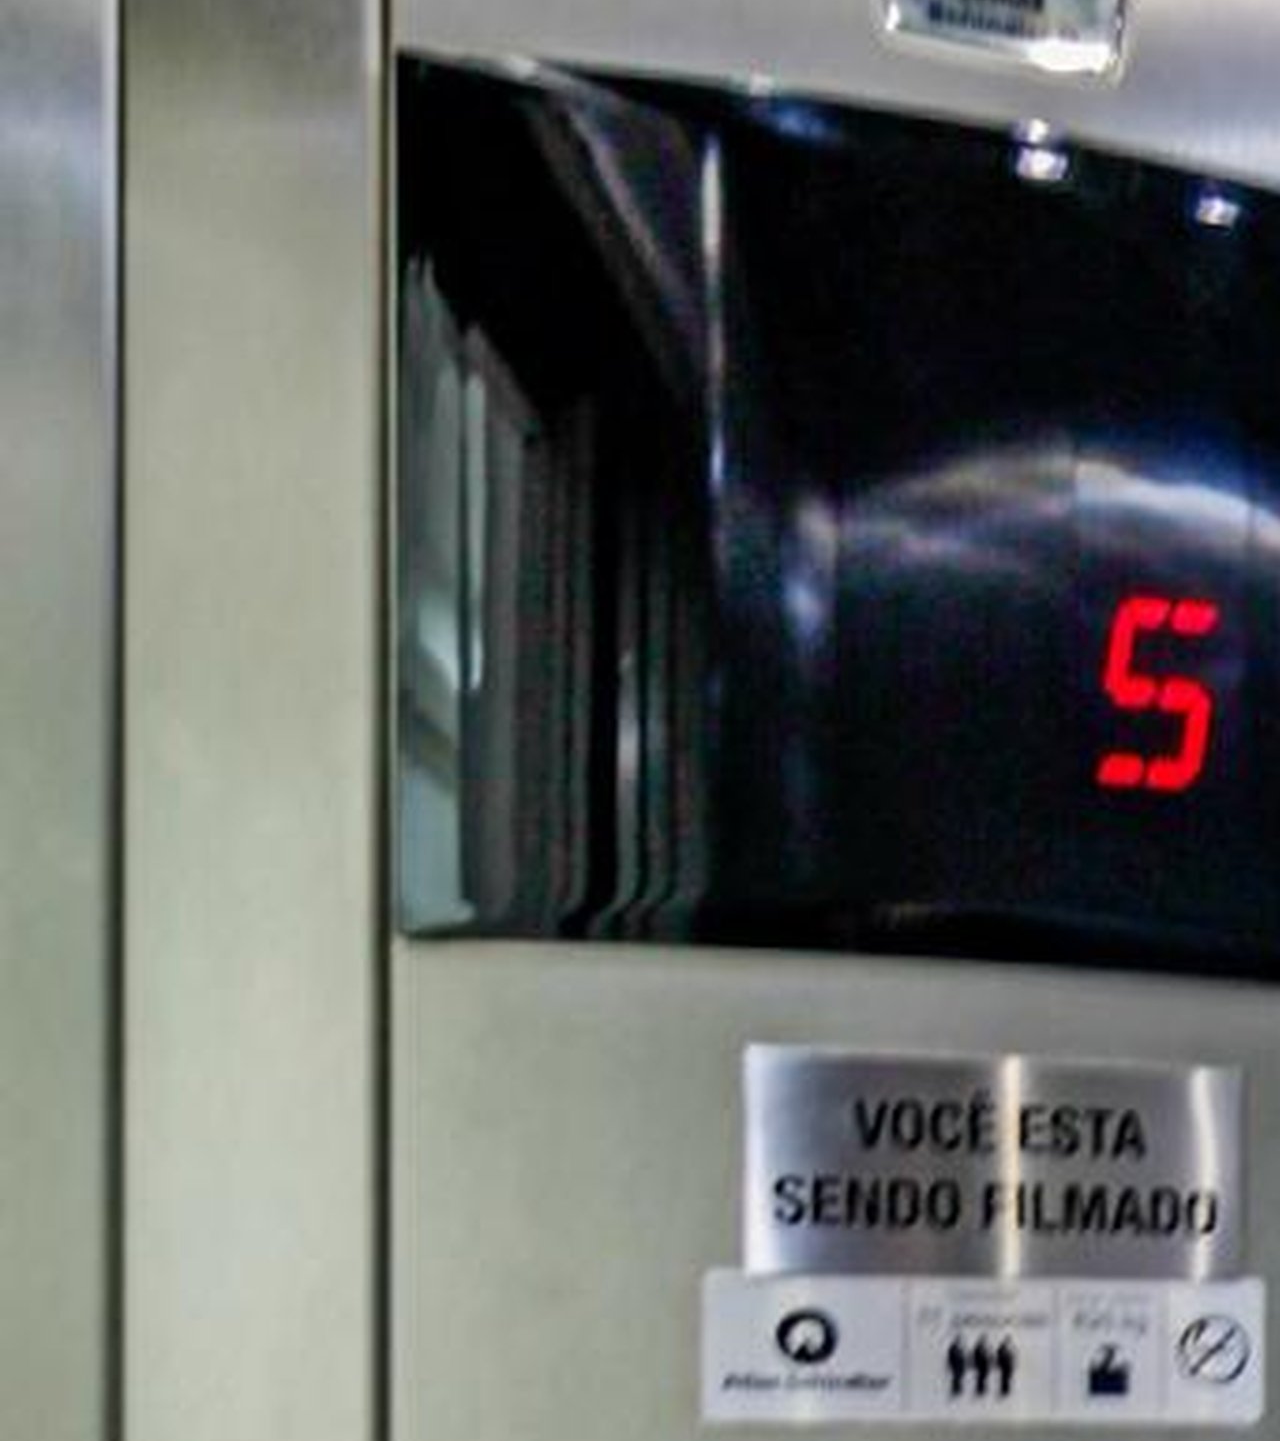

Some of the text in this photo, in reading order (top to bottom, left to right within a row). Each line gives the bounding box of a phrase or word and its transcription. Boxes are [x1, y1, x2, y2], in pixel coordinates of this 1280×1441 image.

[1094, 595, 1219, 795] 5
[853, 1089, 1149, 1160] VOCÊ ESTA
[774, 1174, 1219, 1237] SENDO FILMADO
